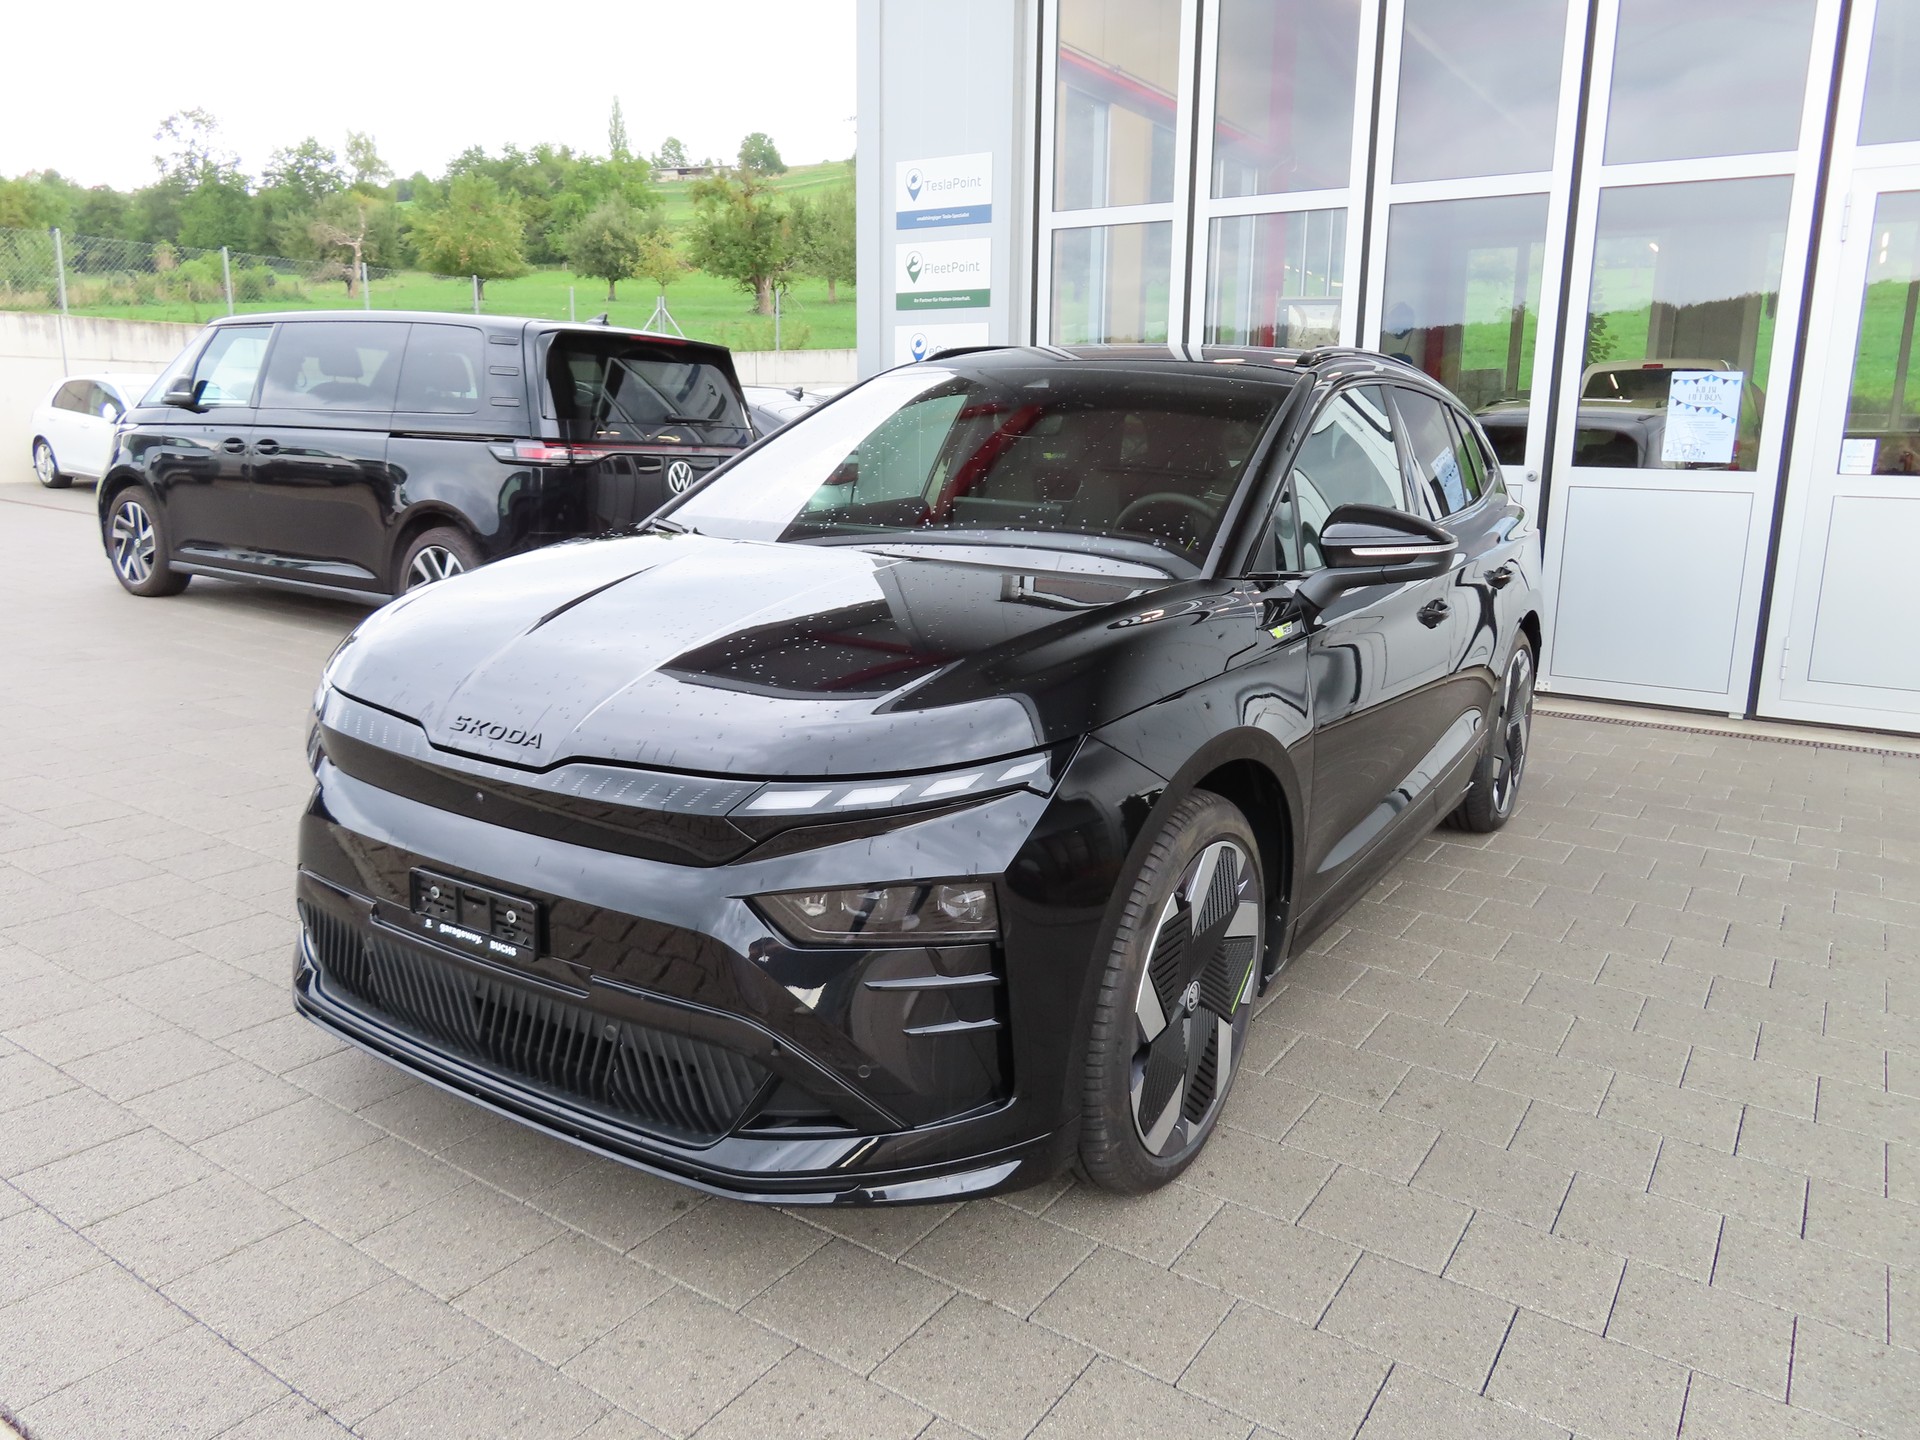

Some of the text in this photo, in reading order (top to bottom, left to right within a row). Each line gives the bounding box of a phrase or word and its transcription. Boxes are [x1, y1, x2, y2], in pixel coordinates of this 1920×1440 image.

[924, 175, 982, 192] TeslaPoint
[924, 260, 980, 275] FleetPoint
[489, 940, 517, 957] BUCHS
